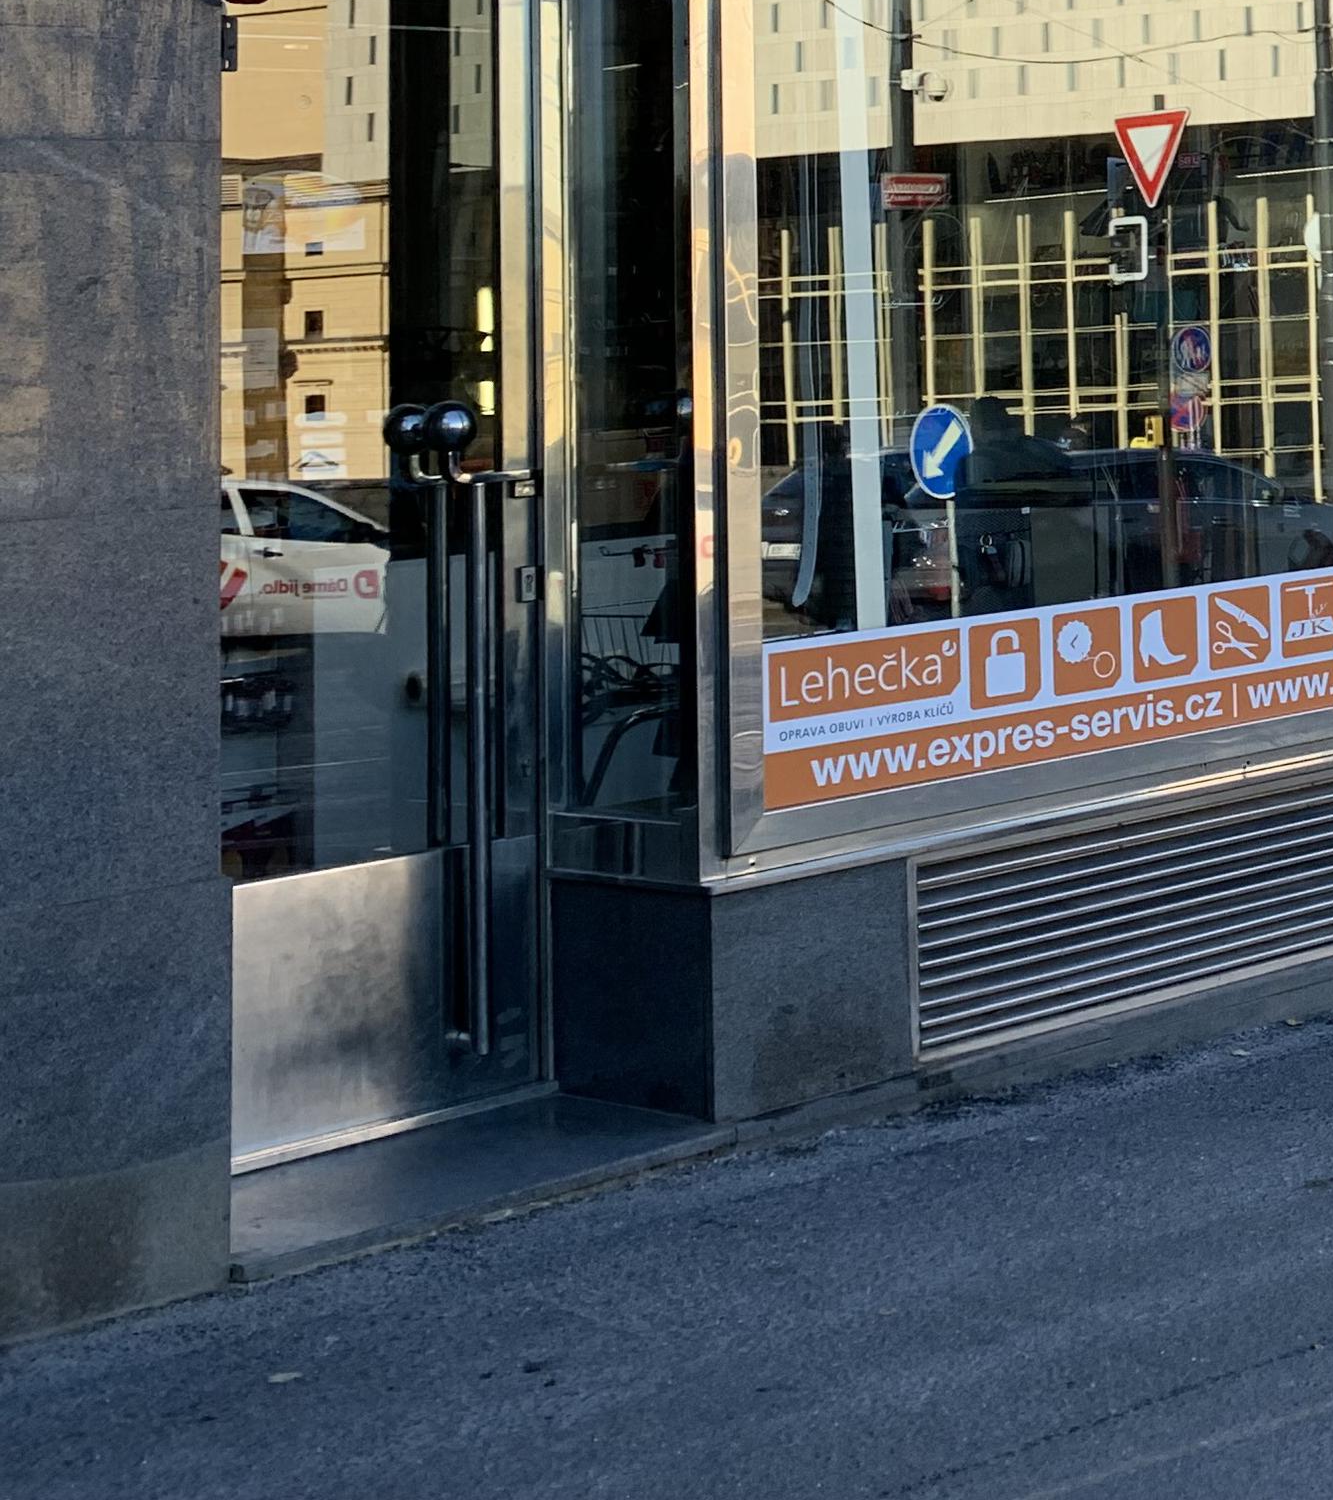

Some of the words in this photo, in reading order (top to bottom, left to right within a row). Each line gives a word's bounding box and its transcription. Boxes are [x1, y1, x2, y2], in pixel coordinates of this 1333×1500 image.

[779, 644, 944, 707] Lehečka
[779, 725, 826, 742] OPRAVA
[829, 719, 864, 734] OBUVI
[877, 709, 921, 727] VÝROBA
[924, 701, 954, 718] KLÍČŮ
[810, 690, 1223, 788] www.expres-servis.cz
